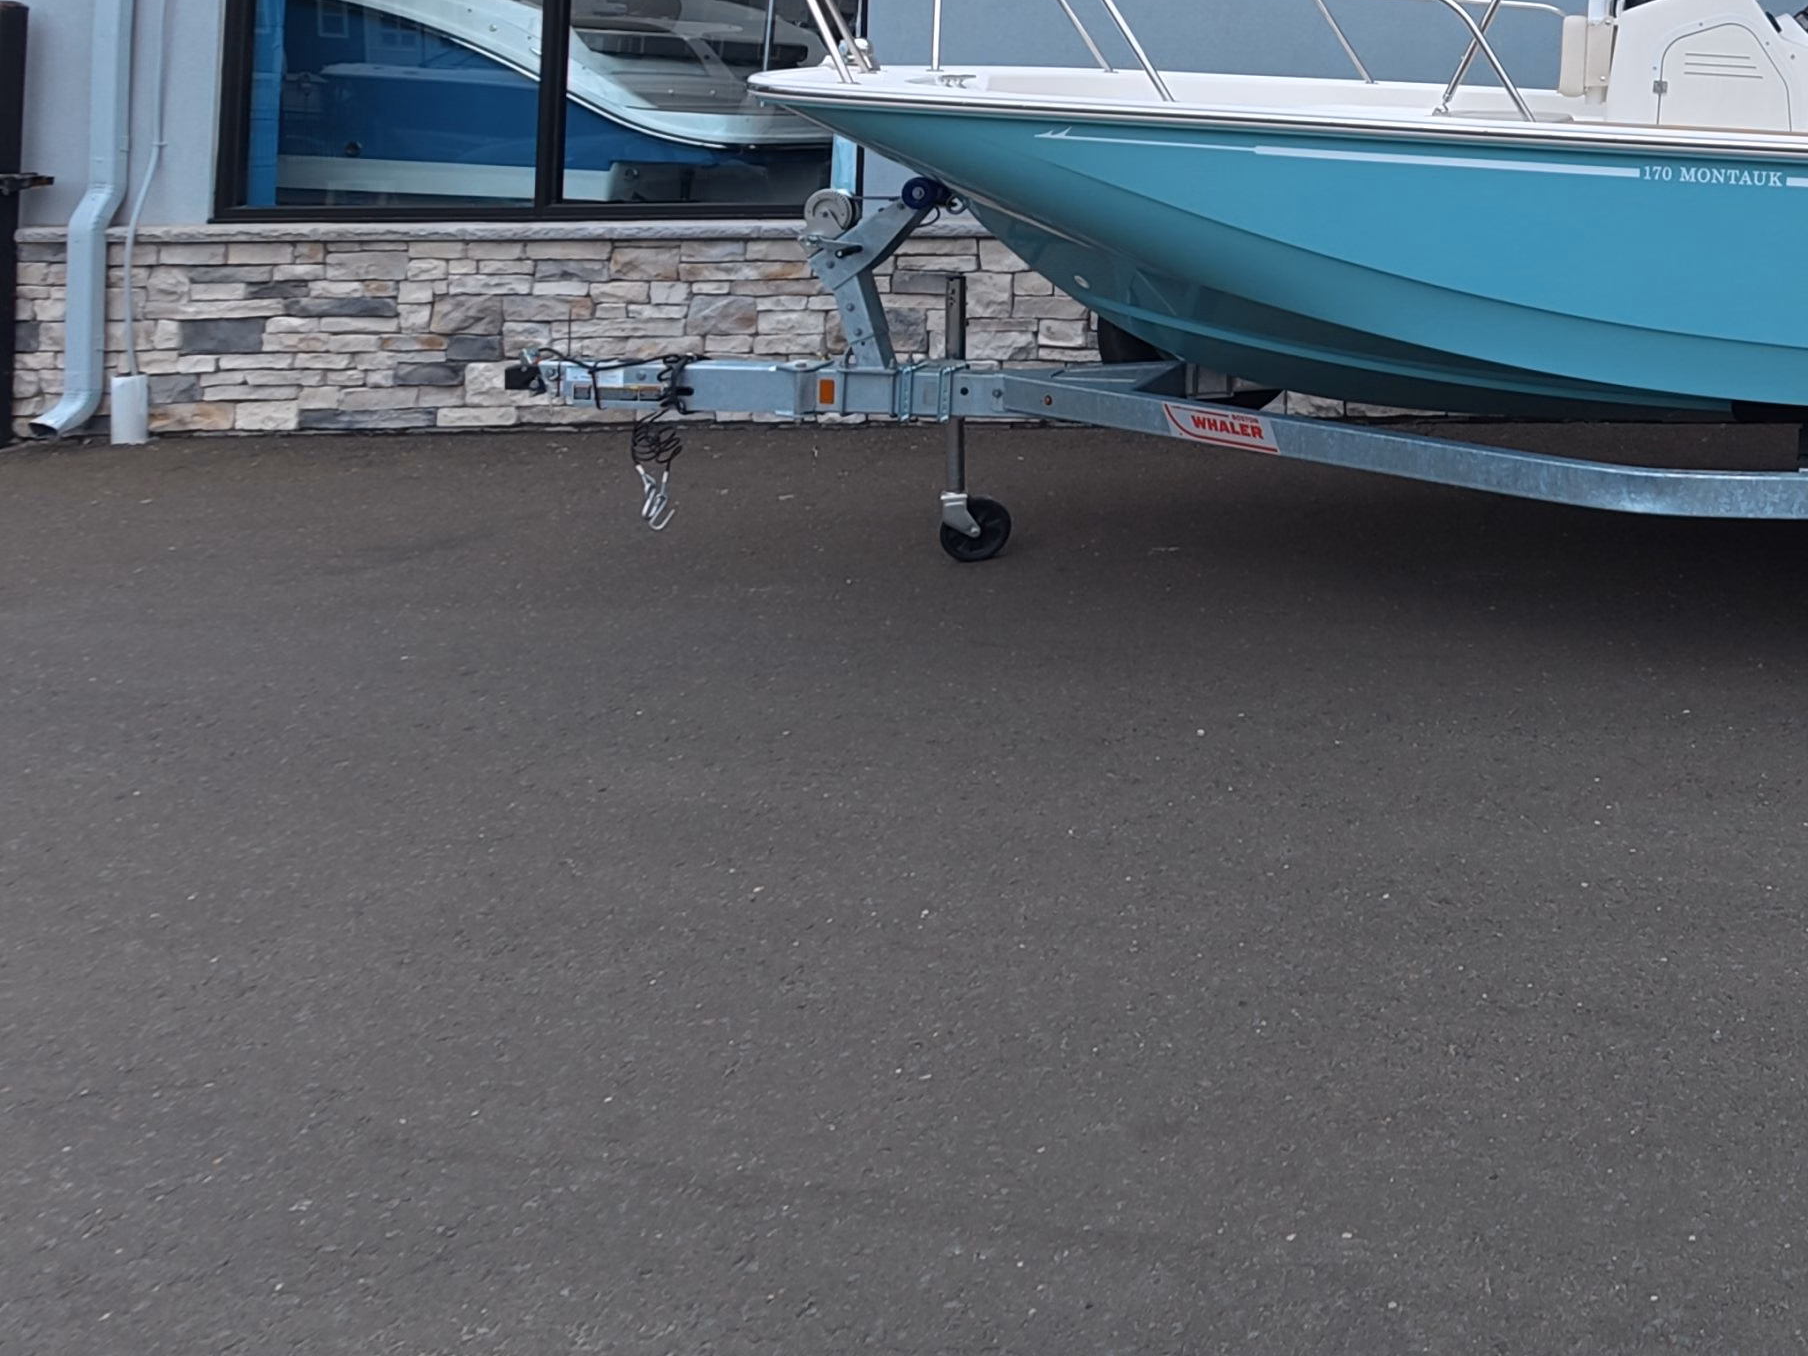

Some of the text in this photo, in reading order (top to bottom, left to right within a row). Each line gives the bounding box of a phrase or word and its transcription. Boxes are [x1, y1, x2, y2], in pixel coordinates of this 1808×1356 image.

[1643, 165, 1783, 187] 170 MONTAUK
[1190, 415, 1265, 440] WHALER
[1231, 414, 1260, 424] BOSTON
